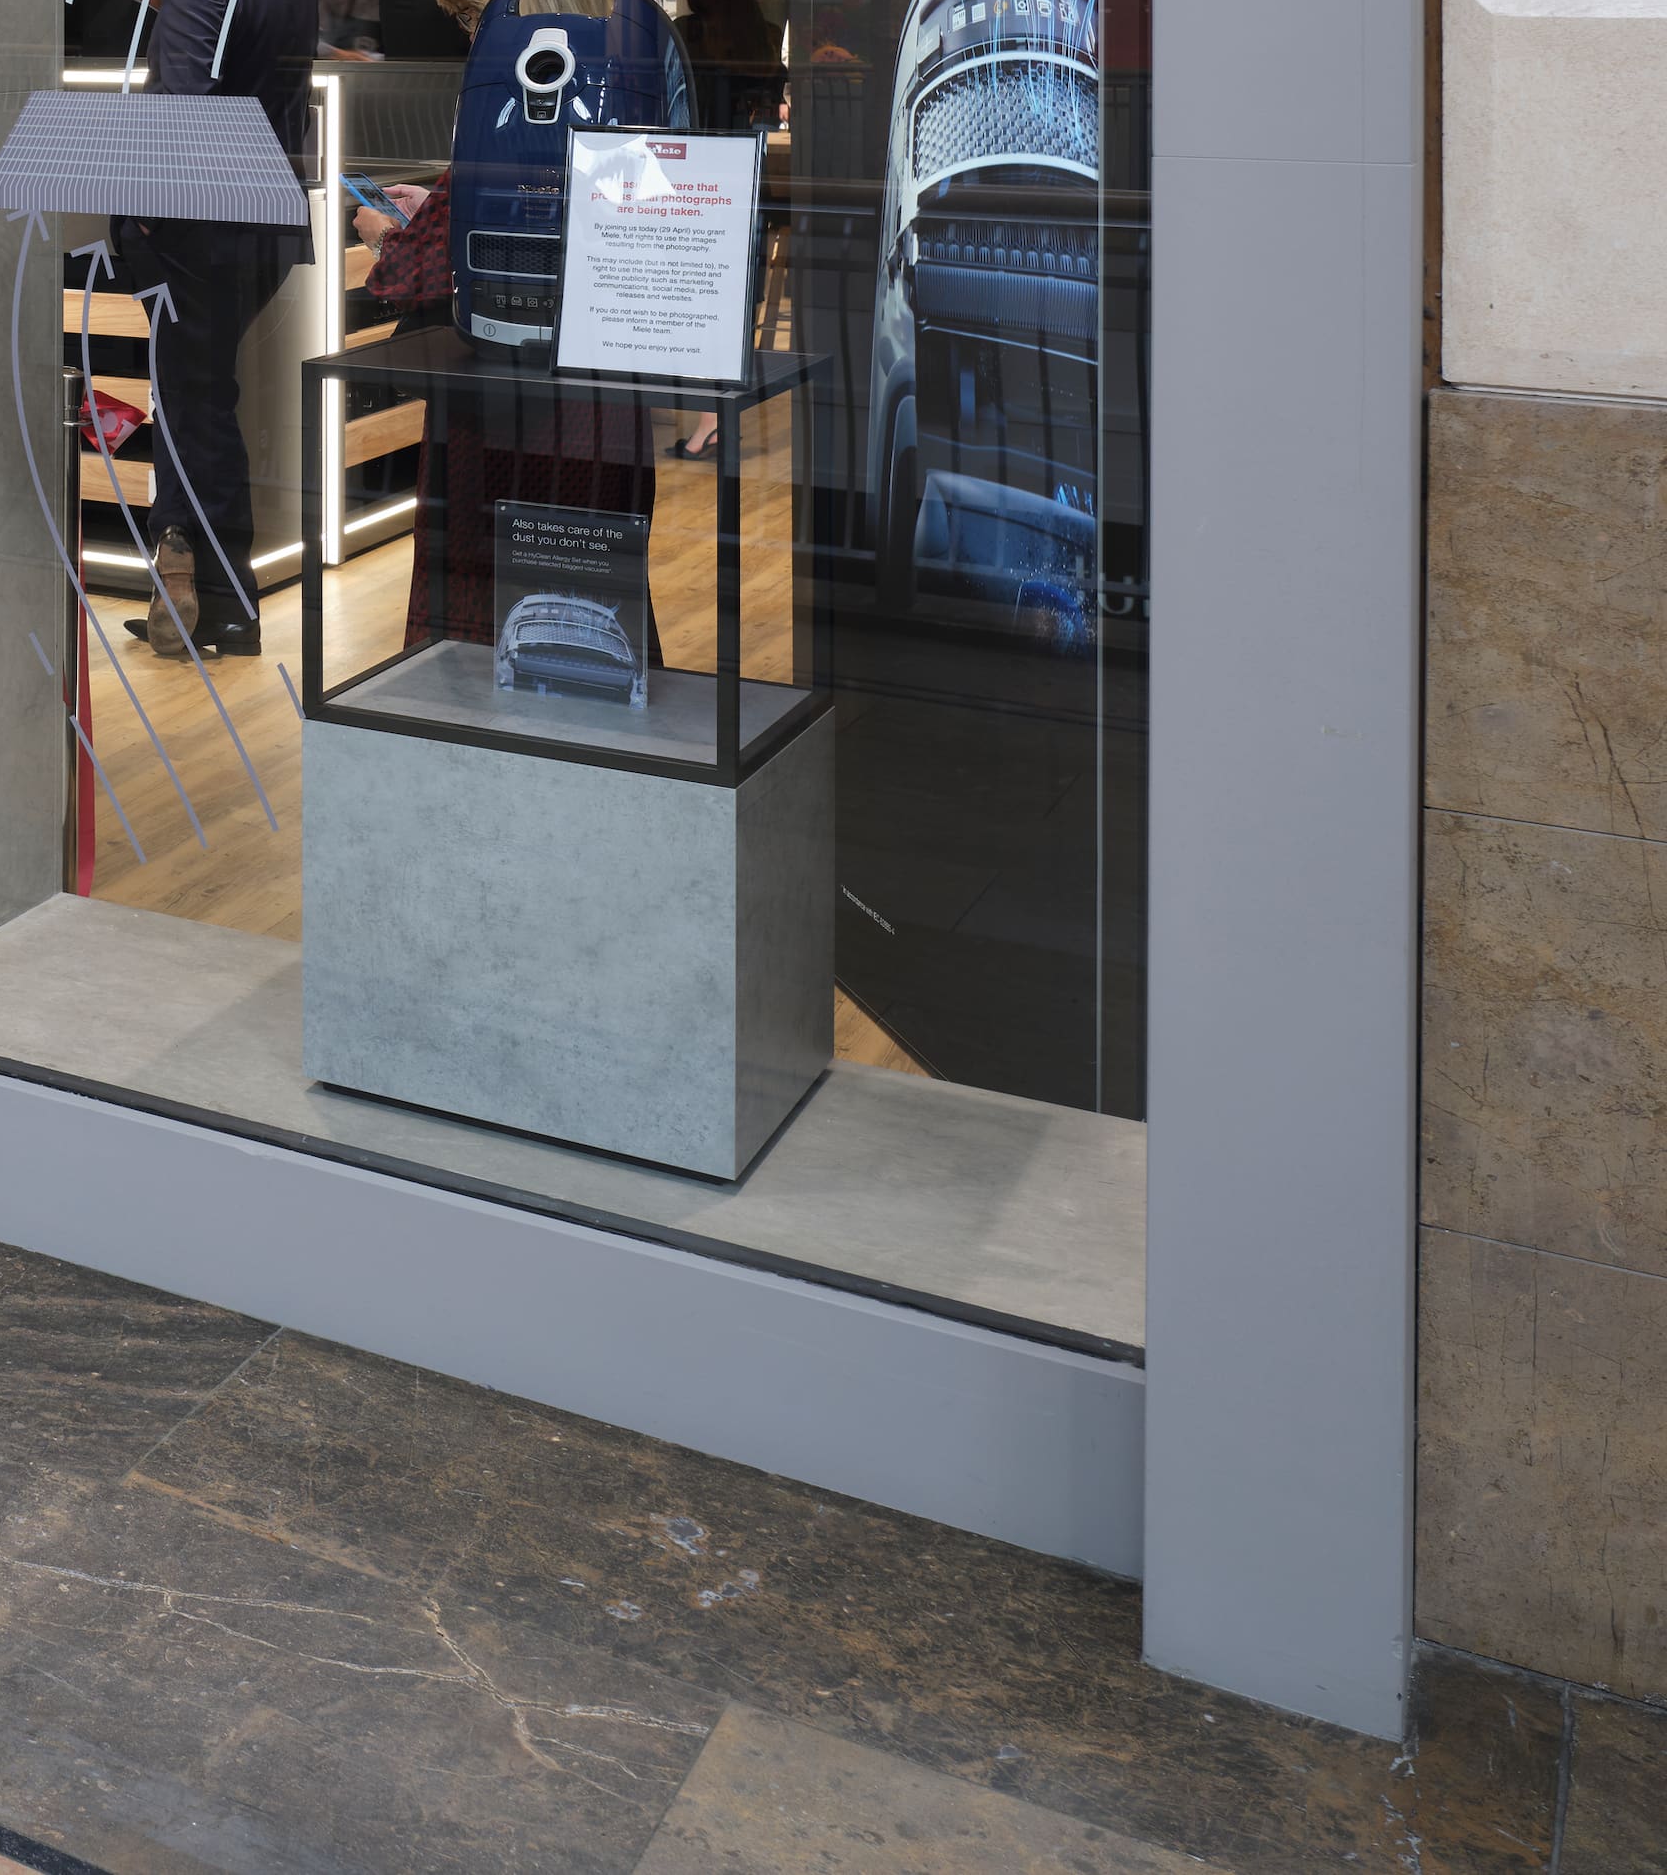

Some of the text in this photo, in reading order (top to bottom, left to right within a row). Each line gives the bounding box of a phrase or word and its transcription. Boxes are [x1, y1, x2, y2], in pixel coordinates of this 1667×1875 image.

[696, 183, 719, 193] that
[661, 195, 732, 207] photographs
[617, 205, 704, 217] are being taken.
[604, 224, 627, 232] joining
[638, 225, 658, 234] today
[659, 226, 671, 234] (29
[672, 226, 691, 235] April)
[692, 228, 706, 236] you
[707, 228, 726, 237] grant
[601, 231, 621, 239] Miele,
[635, 233, 654, 242] rights
[691, 236, 717, 245] images
[605, 241, 635, 250] resulting
[665, 244, 711, 253] photography.
[599, 273, 620, 281] online
[621, 274, 650, 284] publicity
[650, 276, 668, 284] such
[679, 277, 714, 287] marketing
[601, 315, 625, 323] please
[655, 318, 685, 327] member
[668, 311, 720, 321] photographed,
[632, 325, 652, 333] Miele
[602, 340, 614, 348] We
[615, 341, 633, 350] hope
[633, 343, 648, 351] you
[648, 344, 668, 353] enjoy
[686, 346, 702, 354] visit.
[511, 518, 623, 540] Also takes care of the
[512, 532, 611, 552] dust you don't see.
